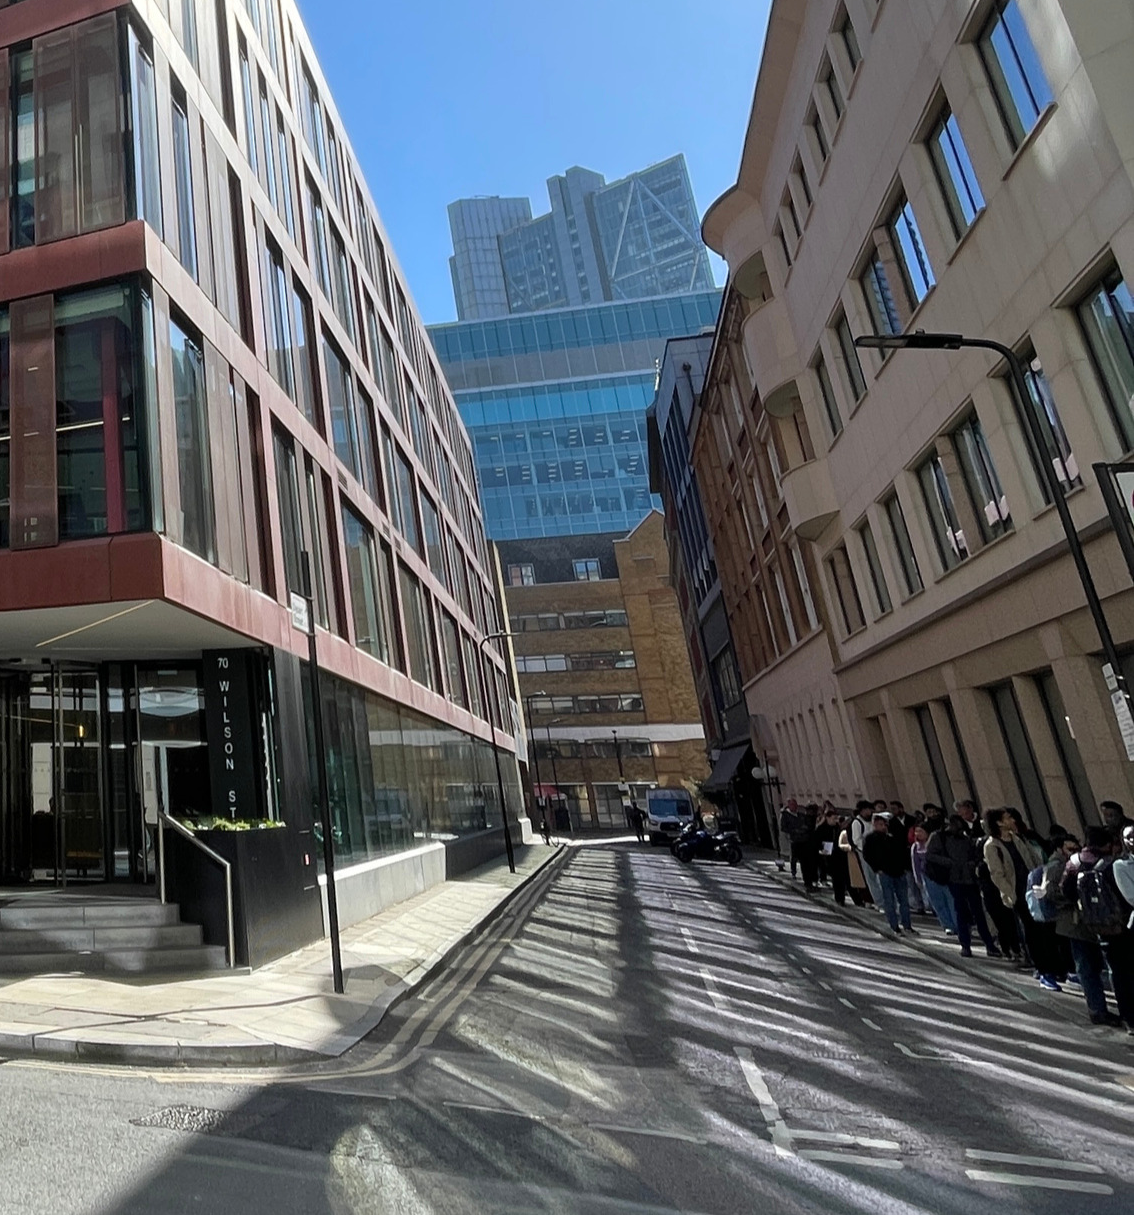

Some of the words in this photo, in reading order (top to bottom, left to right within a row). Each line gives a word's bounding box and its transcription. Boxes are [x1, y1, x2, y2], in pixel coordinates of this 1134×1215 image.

[218, 657, 229, 669] 70
[219, 681, 235, 770] WILSON
[228, 790, 237, 819] ST
